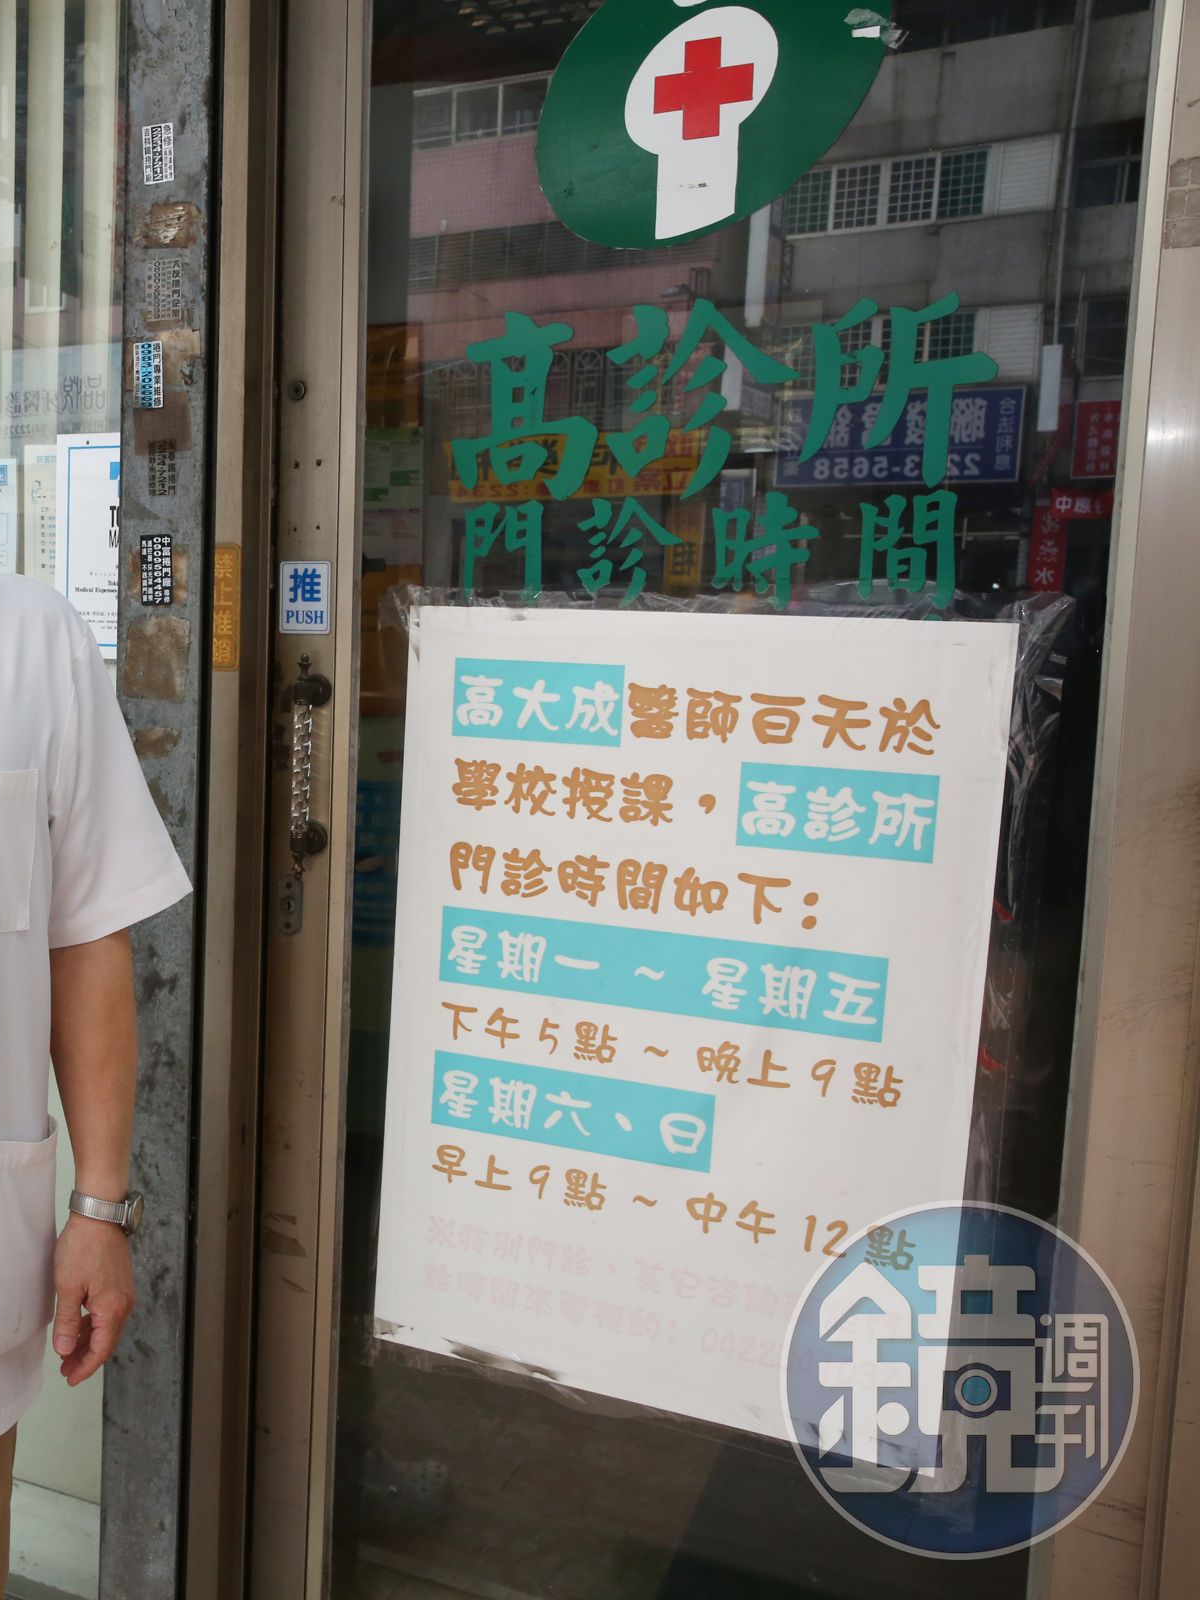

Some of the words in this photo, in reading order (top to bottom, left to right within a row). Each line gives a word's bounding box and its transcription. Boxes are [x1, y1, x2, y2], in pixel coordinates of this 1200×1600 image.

[464, 488, 958, 611] 門診時間
[289, 567, 322, 603] 推
[286, 610, 324, 624] PUSH
